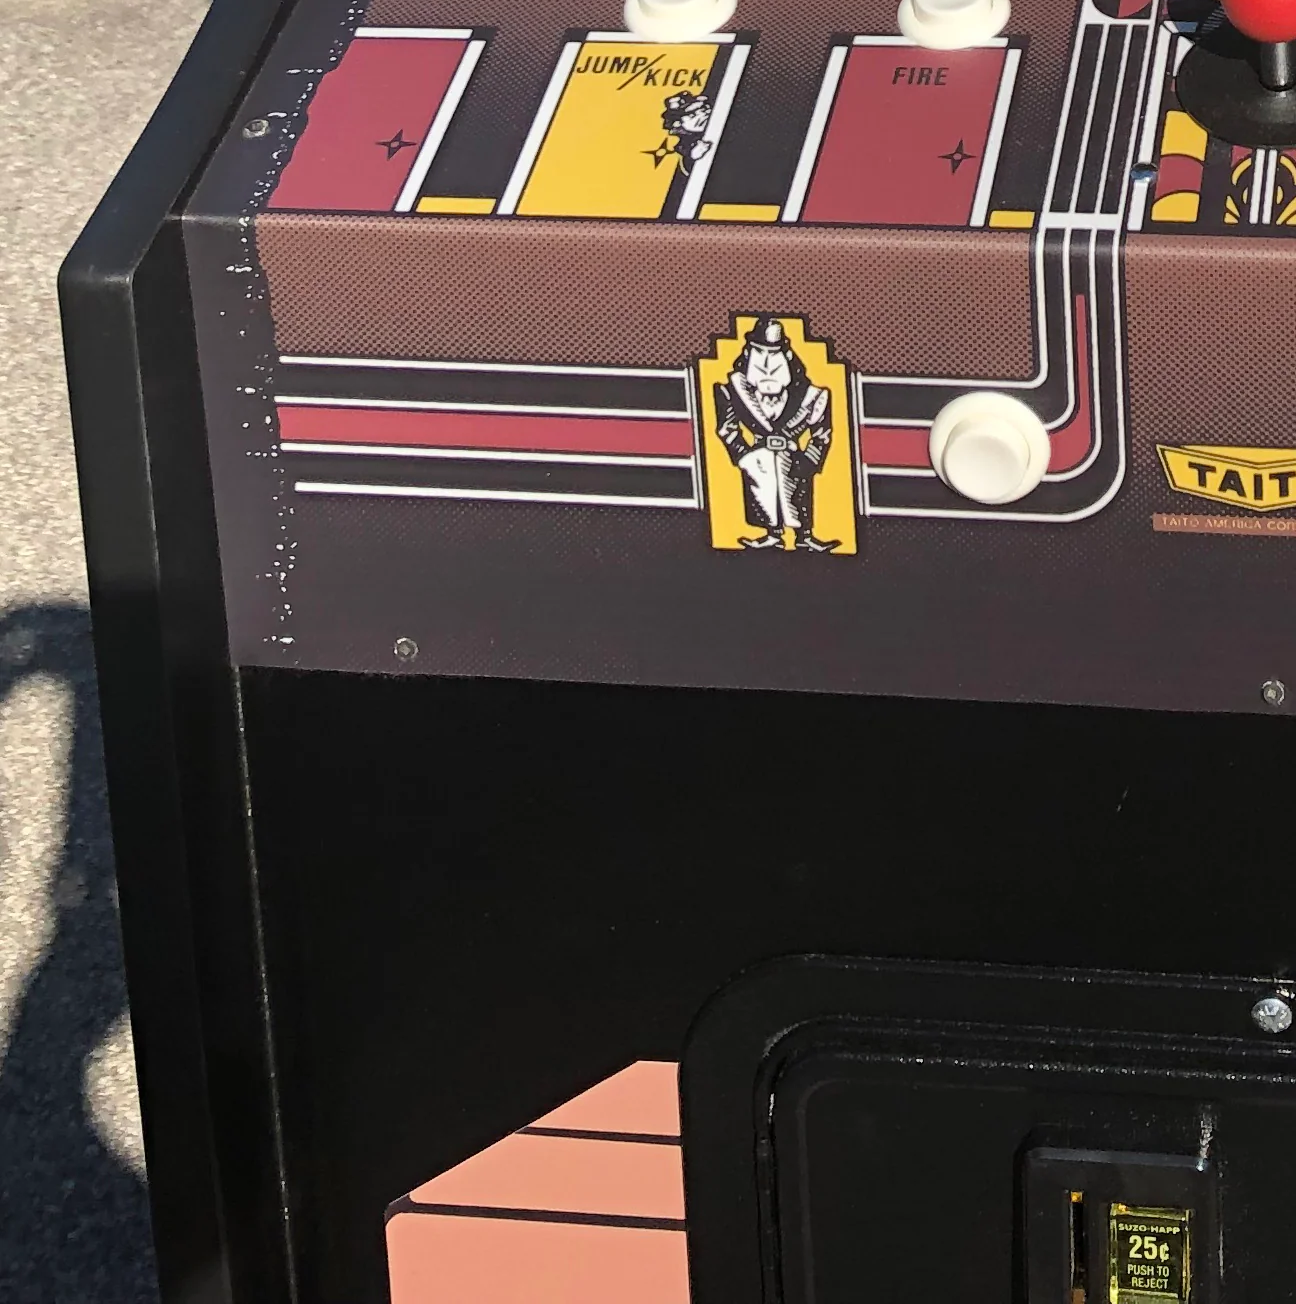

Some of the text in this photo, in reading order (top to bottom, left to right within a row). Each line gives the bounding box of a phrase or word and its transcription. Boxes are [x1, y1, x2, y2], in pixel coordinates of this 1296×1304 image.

[644, 68, 707, 87] KICK
[892, 66, 950, 86] FIRE
[1162, 516, 1200, 529] TAITO
[1204, 517, 1262, 530] AMERICA
[1129, 1234, 1170, 1262] 25¢
[1128, 1263, 1170, 1277] PUSH TO
[1131, 1277, 1169, 1290] REJECT
